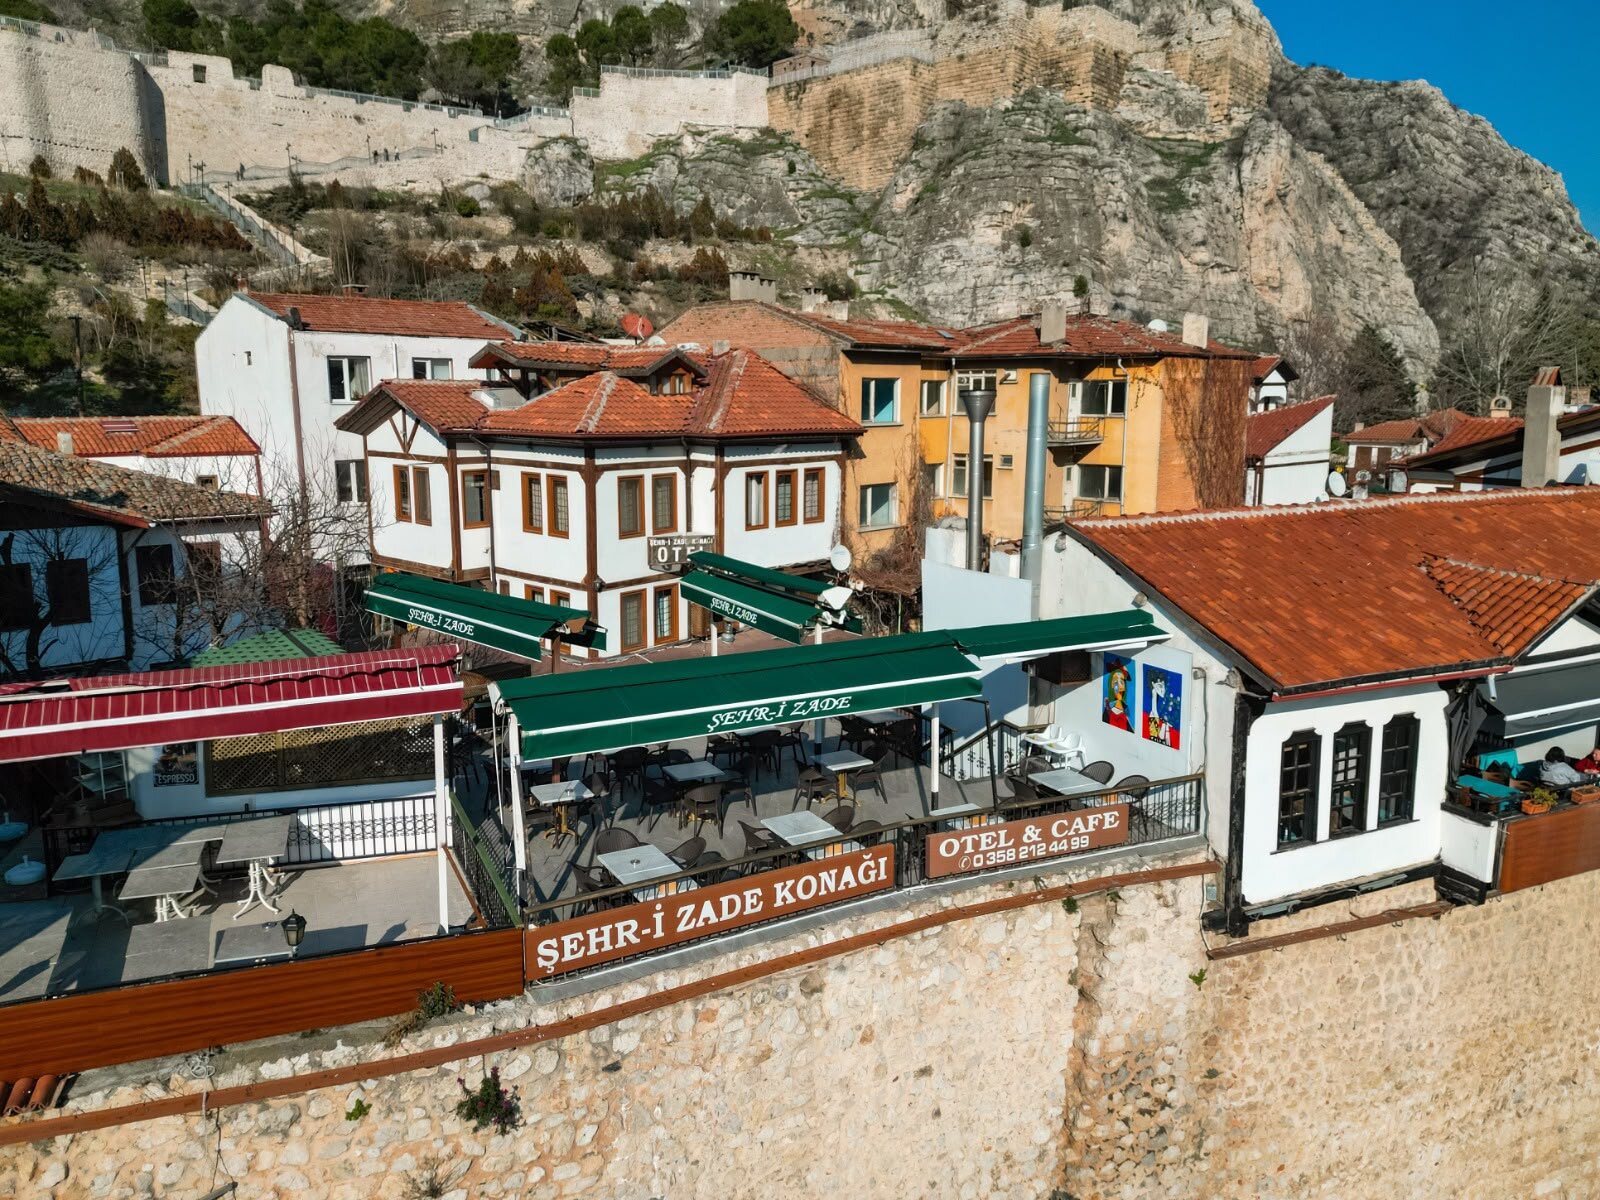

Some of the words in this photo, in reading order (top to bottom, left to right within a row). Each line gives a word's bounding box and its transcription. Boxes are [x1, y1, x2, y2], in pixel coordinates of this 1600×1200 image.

[408, 608, 443, 627] ŞEHR-İ
[443, 618, 475, 636] ZADE
[710, 597, 736, 615] ŞEHR-İ
[735, 606, 758, 624] ZADE
[707, 701, 788, 733] ŞEHR-İ
[789, 696, 852, 716] ZADE
[158, 773, 195, 784] ESPRESSO
[939, 828, 1014, 857] OTEL
[1022, 825, 1042, 843] &
[1051, 811, 1120, 838] CAFE
[986, 848, 1016, 866] 358
[1018, 842, 1047, 860] 212
[1048, 840, 1069, 853] 44
[1070, 835, 1090, 849] 99
[537, 904, 665, 973] ŞEHR-İ
[676, 889, 763, 933] ZADE
[773, 853, 888, 908] KONAĞI
